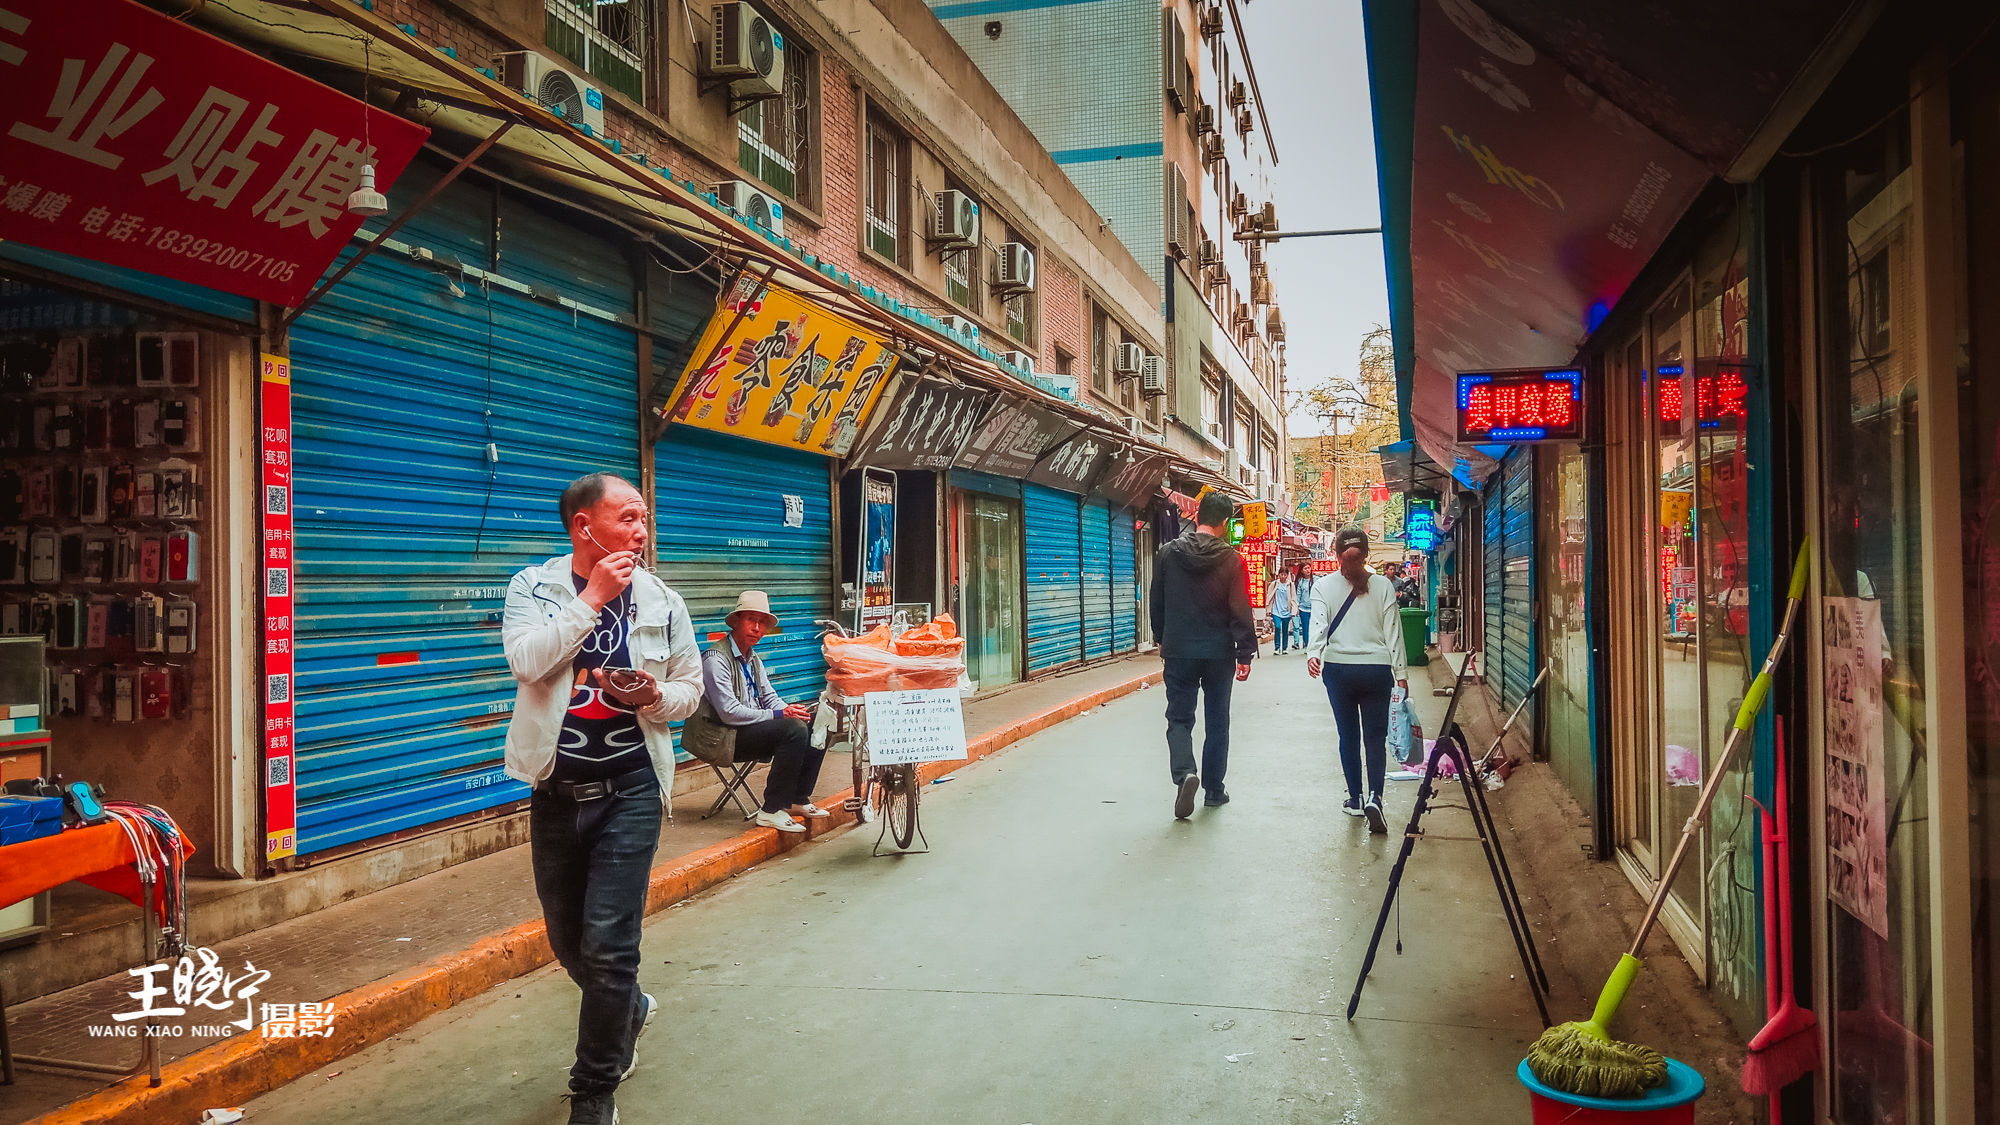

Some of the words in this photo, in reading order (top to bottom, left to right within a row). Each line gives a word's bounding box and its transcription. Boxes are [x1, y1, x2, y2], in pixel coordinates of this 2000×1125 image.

[264, 360, 287, 378] 秒回
[264, 427, 288, 443] 花呗
[264, 449, 288, 466] 套现
[265, 528, 291, 542] 信用卡
[269, 547, 287, 560] 套现
[266, 615, 290, 632] 花呗
[267, 638, 290, 655] 套现
[266, 716, 292, 731] 信用卡
[270, 735, 288, 749] 套现
[268, 834, 292, 853] 秒回
